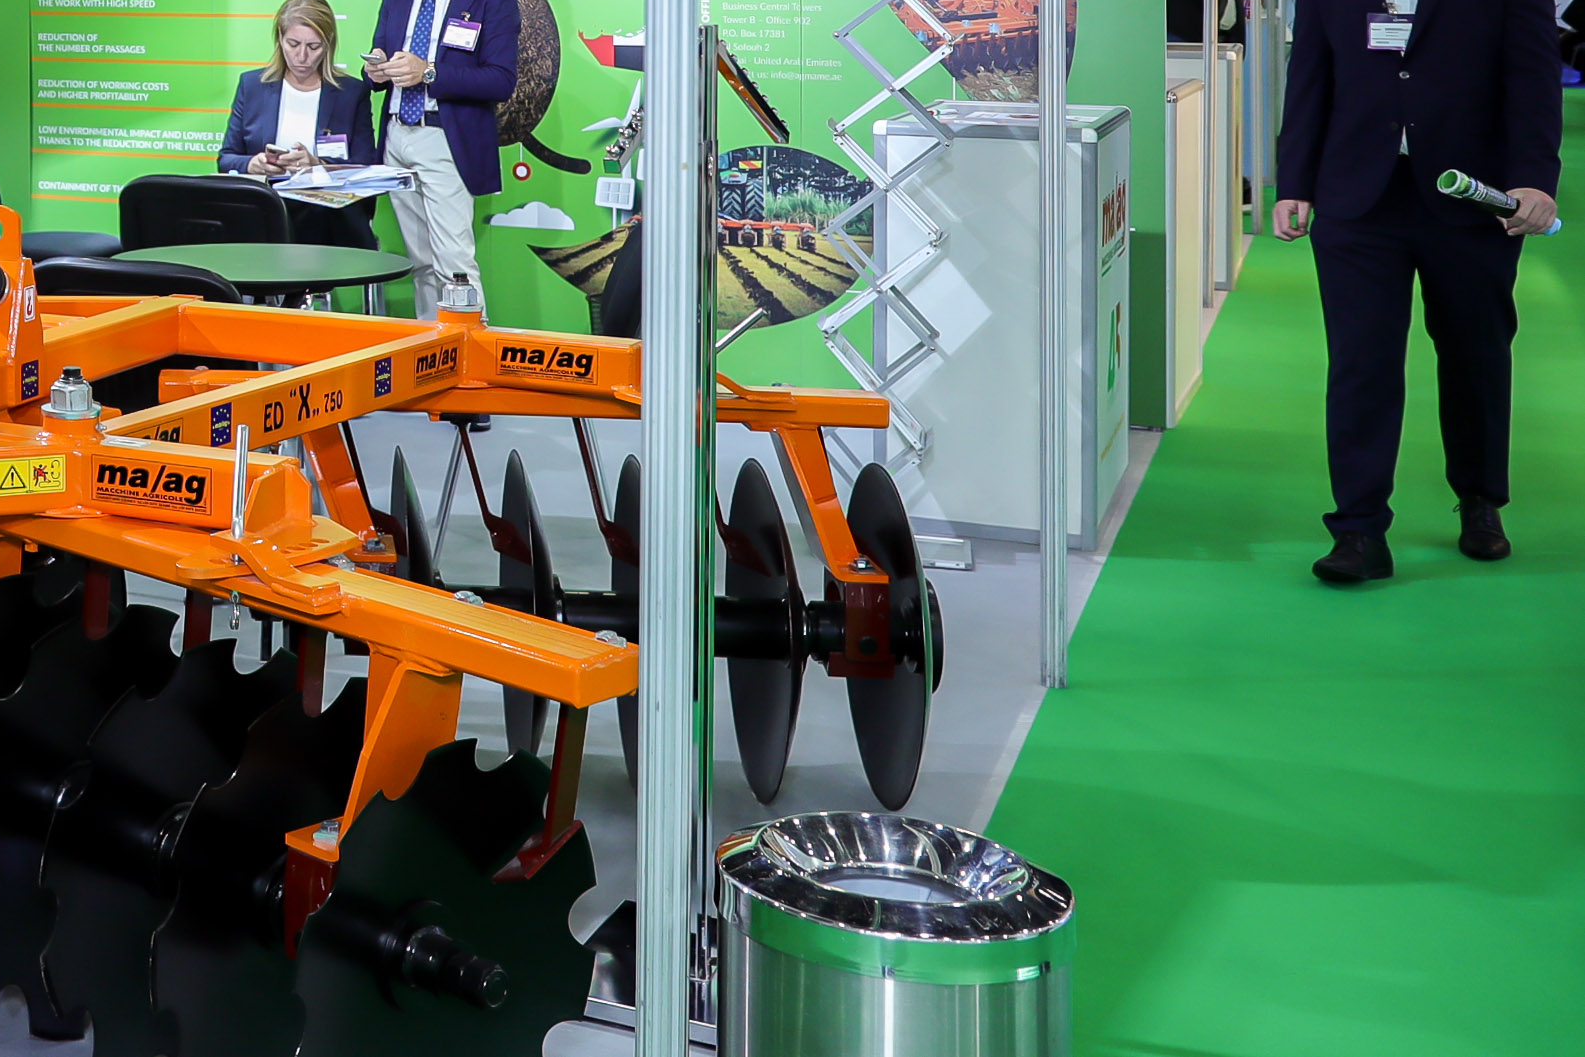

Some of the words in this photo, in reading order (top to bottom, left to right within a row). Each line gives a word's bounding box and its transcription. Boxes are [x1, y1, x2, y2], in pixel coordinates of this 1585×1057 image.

[55, 0, 81, 7] WORK
[82, 0, 105, 7] WITH
[106, 0, 128, 8] HIGH
[129, 0, 156, 9] SPEED
[722, 2, 757, 11] Business
[760, 2, 790, 11] Central
[793, 3, 822, 12] Towers
[722, 15, 747, 24] Tower
[749, 16, 756, 24] B
[766, 16, 791, 25] Office
[794, 17, 811, 25] 902
[37, 33, 85, 42] REDUCTION
[87, 33, 98, 42] OF
[722, 29, 738, 37] P.O.
[741, 29, 756, 37] Box
[759, 30, 785, 38] 17381
[37, 44, 54, 52] THE
[55, 44, 90, 53] NUMBER
[92, 45, 104, 53] OF
[105, 45, 146, 54] PASSAGES
[765, 43, 770, 51] 2
[754, 58, 782, 66] United
[784, 58, 802, 67] Arab
[806, 59, 842, 67] Emirates
[37, 79, 86, 89] REDUCTION
[87, 80, 98, 89] OF
[100, 81, 141, 90] WORKING
[142, 82, 169, 91] COSTS
[37, 90, 56, 99] AND
[57, 91, 89, 100] HIGHER
[90, 92, 149, 102] PROFITABILITY
[38, 125, 57, 134] LOW
[58, 126, 129, 138] ENVIRONMENTAL
[129, 129, 162, 138] IMPACT
[162, 130, 182, 139] AND
[183, 131, 214, 140] LOWER
[38, 136, 71, 145] THANKS
[72, 137, 84, 146] TO
[85, 138, 102, 146] THE
[103, 139, 151, 149] REDUCTION
[152, 141, 165, 150] OF
[166, 141, 183, 151] THE
[185, 142, 206, 152] FUEL
[38, 180, 98, 192] CONTAINMENT
[99, 183, 112, 192] OF
[416, 346, 458, 373] ma/ag
[501, 347, 594, 376] ma/ag
[501, 364, 536, 372] MACCHINE
[264, 401, 284, 433] ED
[324, 389, 343, 413] 750
[96, 464, 207, 505] ma/ag
[96, 486, 139, 497] MACCHINE
[142, 492, 184, 502] AGRICOLE
